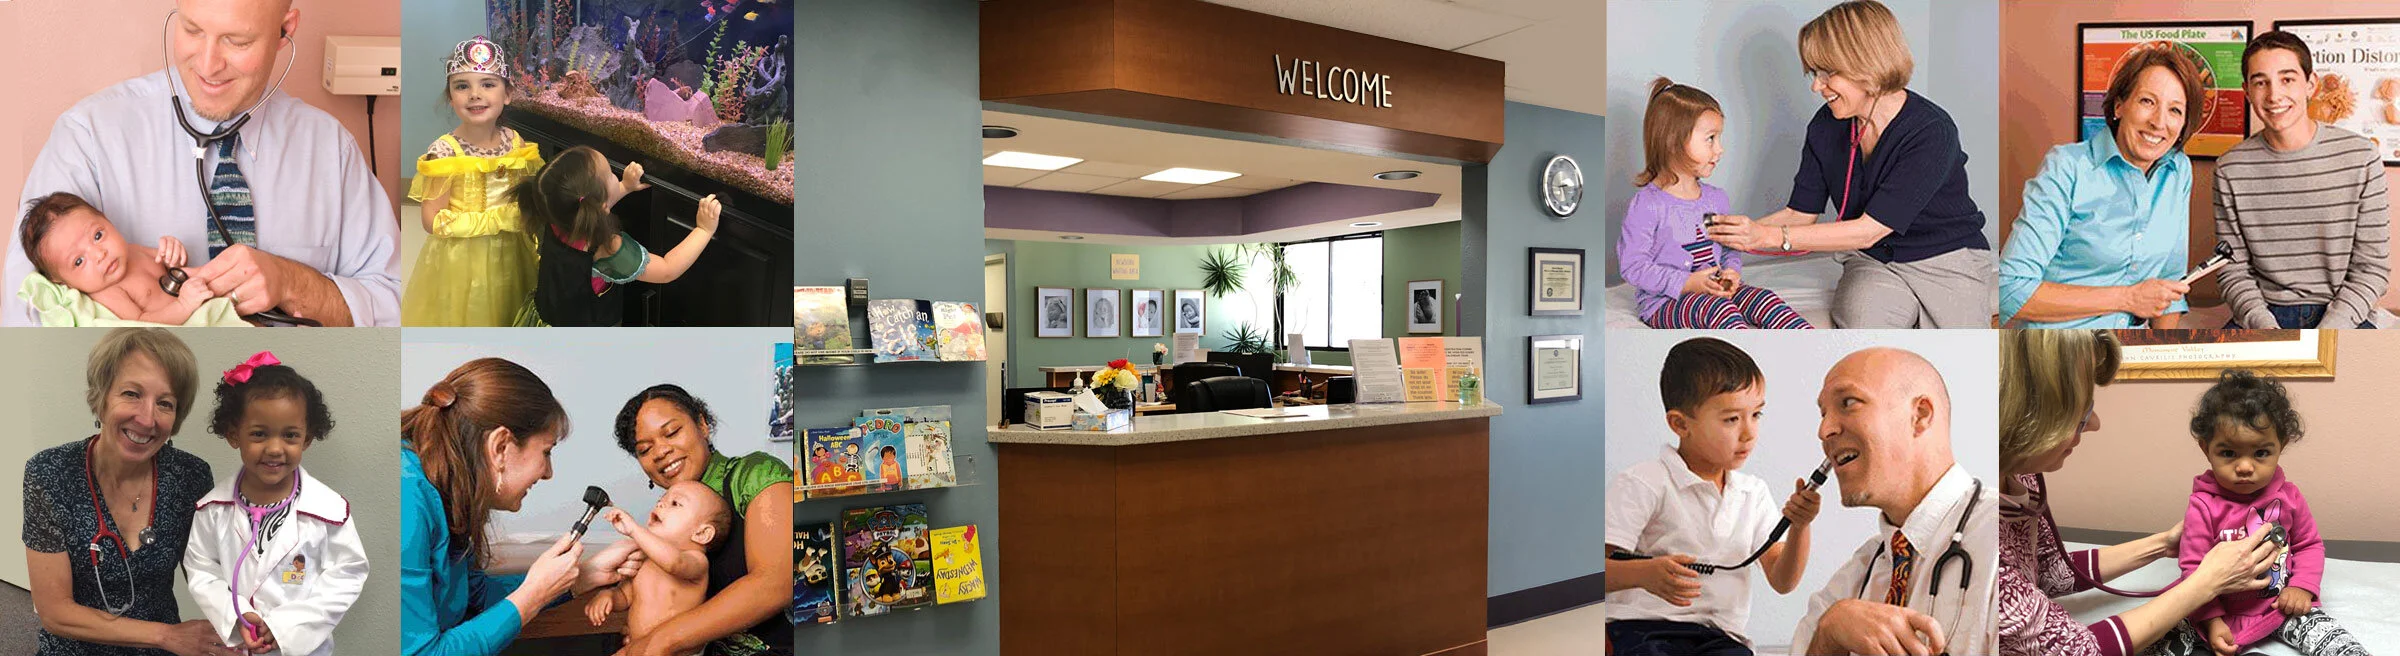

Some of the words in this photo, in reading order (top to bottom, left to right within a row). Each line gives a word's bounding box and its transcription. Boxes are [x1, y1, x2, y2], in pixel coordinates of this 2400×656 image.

[2120, 30, 2138, 39] The
[2140, 30, 2154, 39] US
[2156, 29, 2180, 39] Food
[2182, 29, 2207, 39] Plate
[1275, 54, 1393, 108] WELCOME
[873, 303, 895, 320] How
[886, 308, 915, 327] Catch
[916, 311, 929, 323] an
[861, 419, 901, 436] PEDRO
[818, 434, 851, 443] Halloween
[821, 472, 832, 483] A
[833, 466, 842, 477] B
[867, 513, 905, 532] PAW
[2219, 525, 2246, 541] IT'S
[936, 558, 978, 580] WEDNESDAY
[958, 576, 982, 595] WACKY
